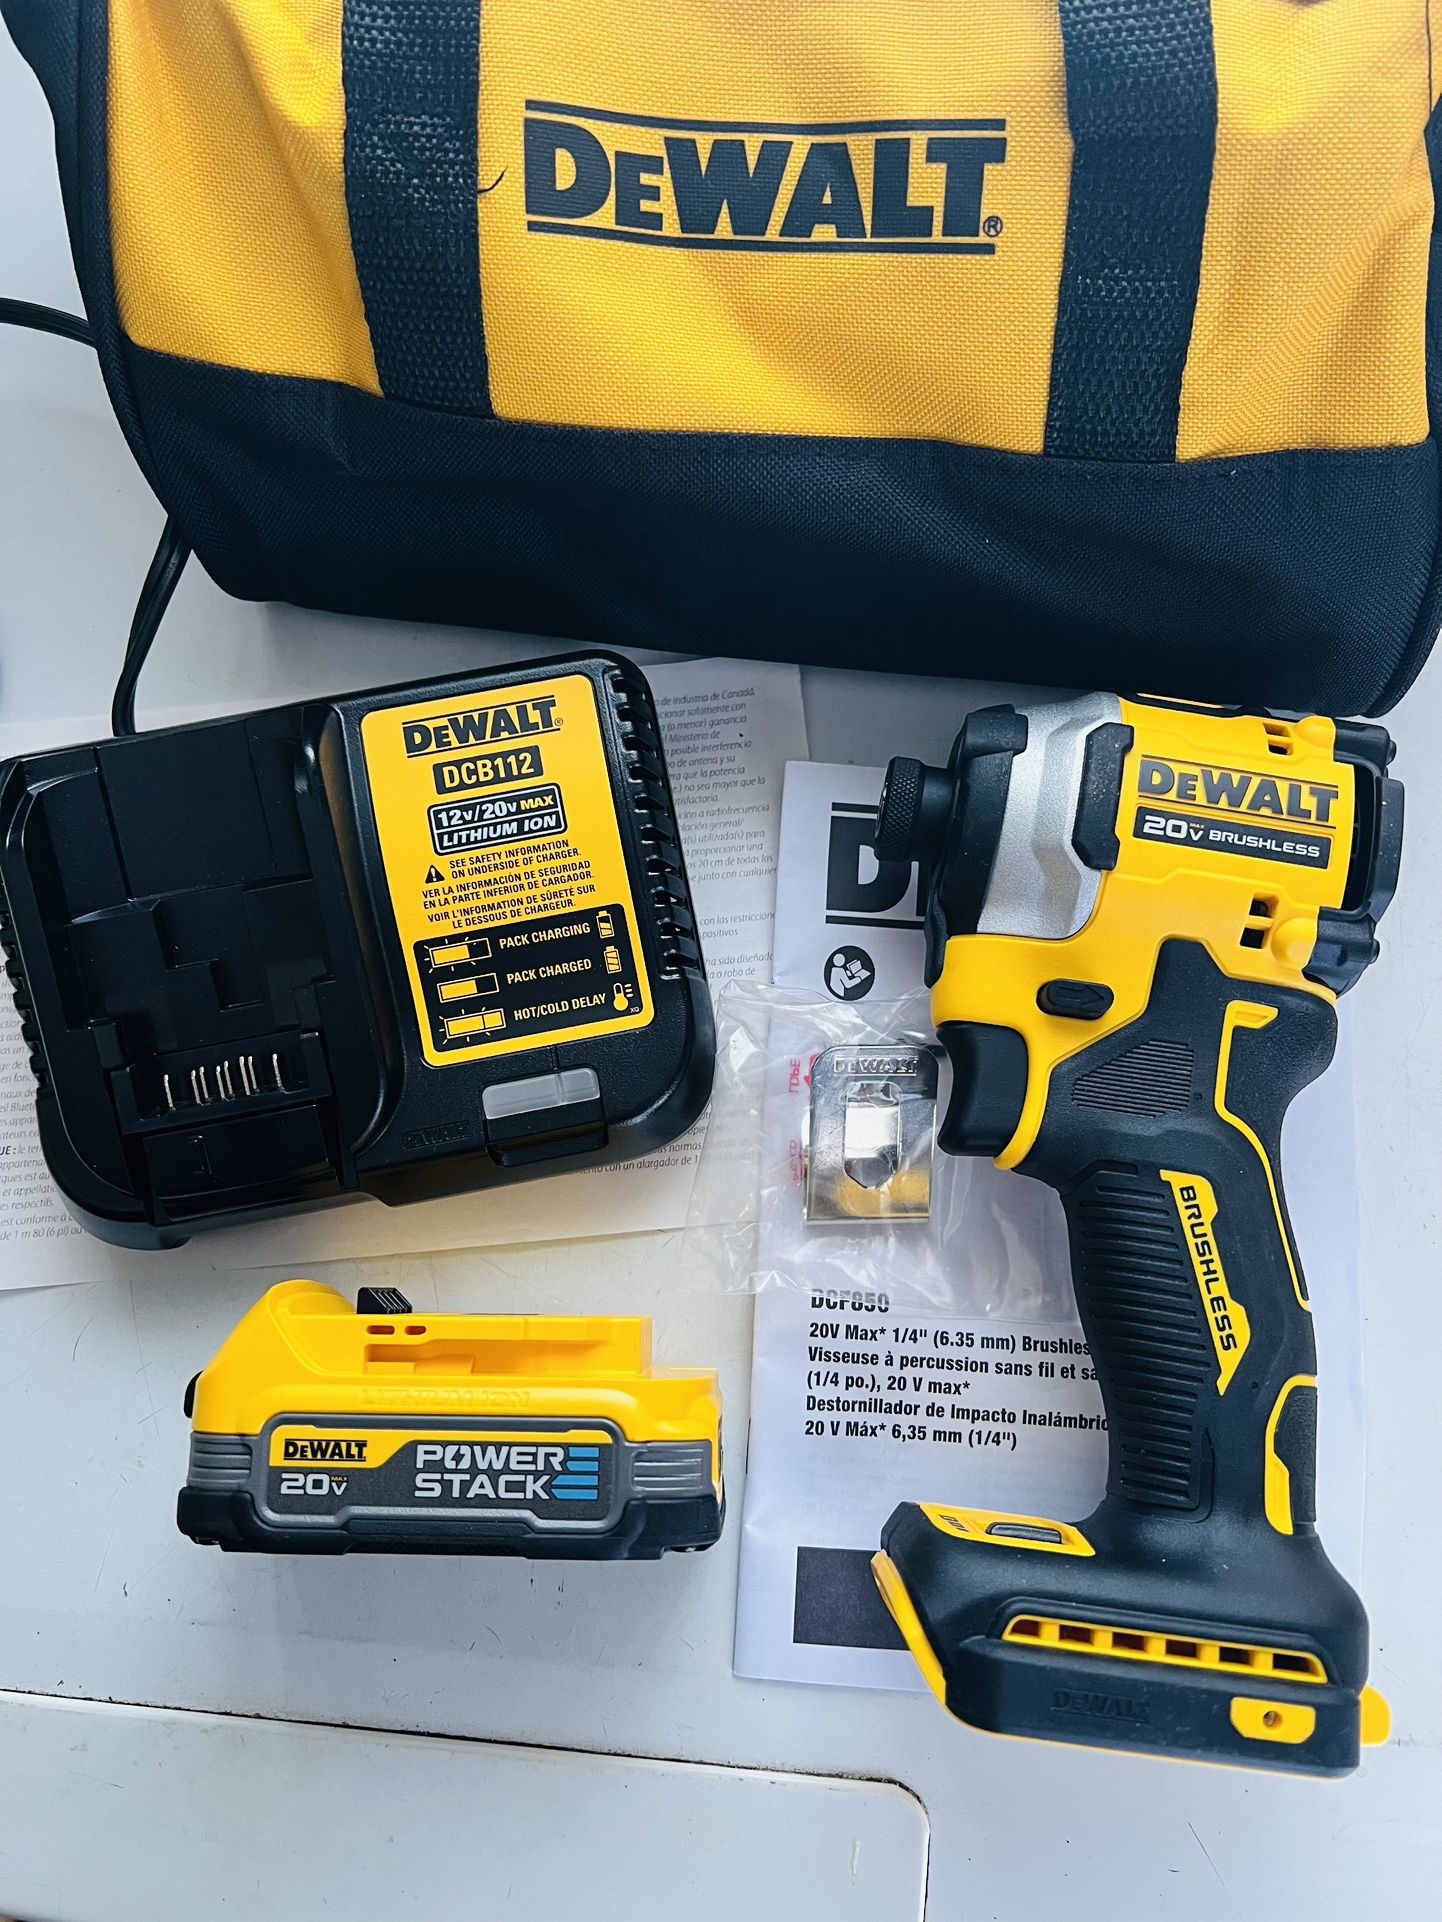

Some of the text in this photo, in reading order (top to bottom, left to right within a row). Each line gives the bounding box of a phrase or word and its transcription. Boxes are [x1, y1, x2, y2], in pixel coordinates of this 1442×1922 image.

[731, 702, 746, 711] con
[710, 730, 720, 739] de
[443, 752, 535, 788] DCB112
[726, 755, 735, 763] su
[682, 771, 698, 780] que
[700, 769, 707, 778] la
[684, 783, 695, 792] no
[697, 781, 710, 790] sea
[757, 776, 766, 785] la
[520, 795, 554, 810] MAX
[1138, 759, 1339, 822] DEWALT
[443, 814, 557, 847] LITHIUM ION
[1209, 829, 1320, 858] BRUSHLESS
[450, 839, 569, 869] SEE SAFETY INFORMATION
[422, 860, 591, 899] VER LA INFORMACIÓN DE SEGURIDAD
[452, 870, 465, 879] ON
[468, 861, 520, 876] UNDERSIDE
[522, 857, 534, 866] OF
[423, 901, 436, 910] EN
[438, 898, 450, 907] LA
[452, 891, 481, 904] PARTE
[483, 883, 525, 899] INFERIOR
[528, 881, 539, 890] DE
[428, 884, 596, 923] VOIR L'INFORMATION DE SÛRETÉ SUR
[452, 920, 463, 929] LE
[466, 912, 508, 927] DESSOUS
[510, 909, 522, 918] DE
[499, 922, 591, 949] PACK CHARGING
[506, 958, 592, 984] PACK CHARGED
[514, 992, 606, 1021] HOT/COLD DELAY
[623, 1161, 635, 1170] un
[680, 1155, 692, 1165] de
[1179, 1185, 1238, 1351] BRUSHLESS
[809, 1322, 840, 1339] 20V
[933, 1330, 975, 1348] (6.35
[981, 1335, 1016, 1354] mm)
[1022, 1336, 1091, 1355] Brushles
[808, 1346, 1098, 1381] Visseuse à percussion sans fil et sa
[807, 1370, 839, 1390] (1/4
[845, 1374, 881, 1392] po.),
[887, 1375, 907, 1391] 20
[913, 1377, 923, 1392] V
[806, 1395, 1108, 1431] Destornillador de Impacto Inalámbric
[805, 1420, 825, 1436] 20
[830, 1420, 841, 1436] V
[891, 1424, 927, 1442] 6,35
[932, 1429, 962, 1443] mm
[284, 1441, 366, 1460] DEWALT
[416, 1444, 566, 1472] POWER
[414, 1473, 552, 1500] STACK
